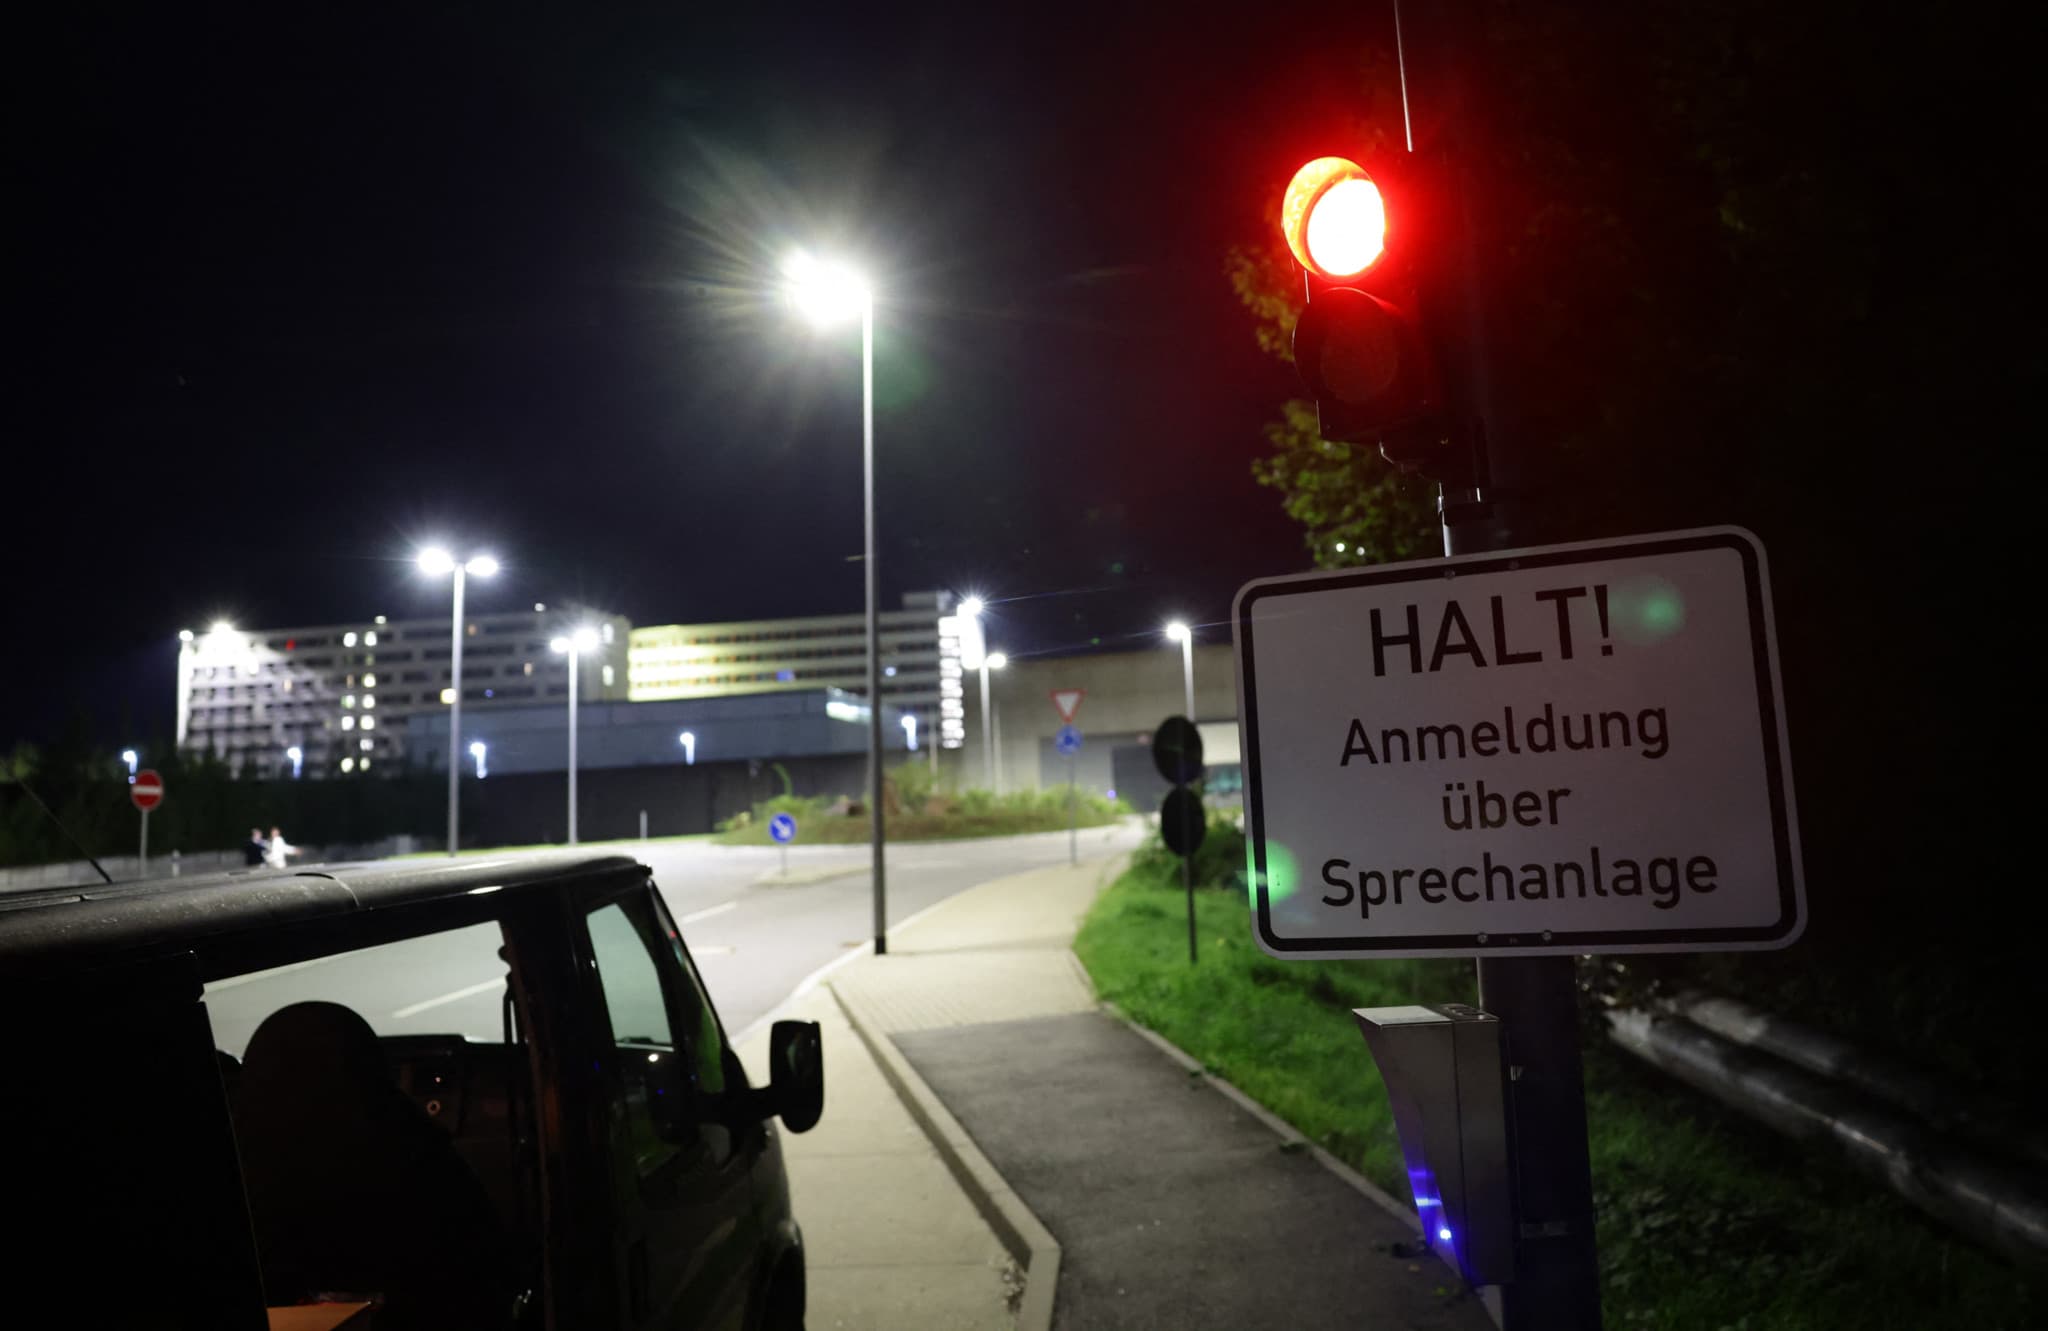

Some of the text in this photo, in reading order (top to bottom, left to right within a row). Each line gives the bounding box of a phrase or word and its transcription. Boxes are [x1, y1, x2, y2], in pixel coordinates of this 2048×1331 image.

[1369, 584, 1613, 677] HALT!
[1339, 703, 1670, 767] Anmeldung
[1442, 780, 1572, 831] über
[1321, 846, 1718, 919] Sprechanlage
